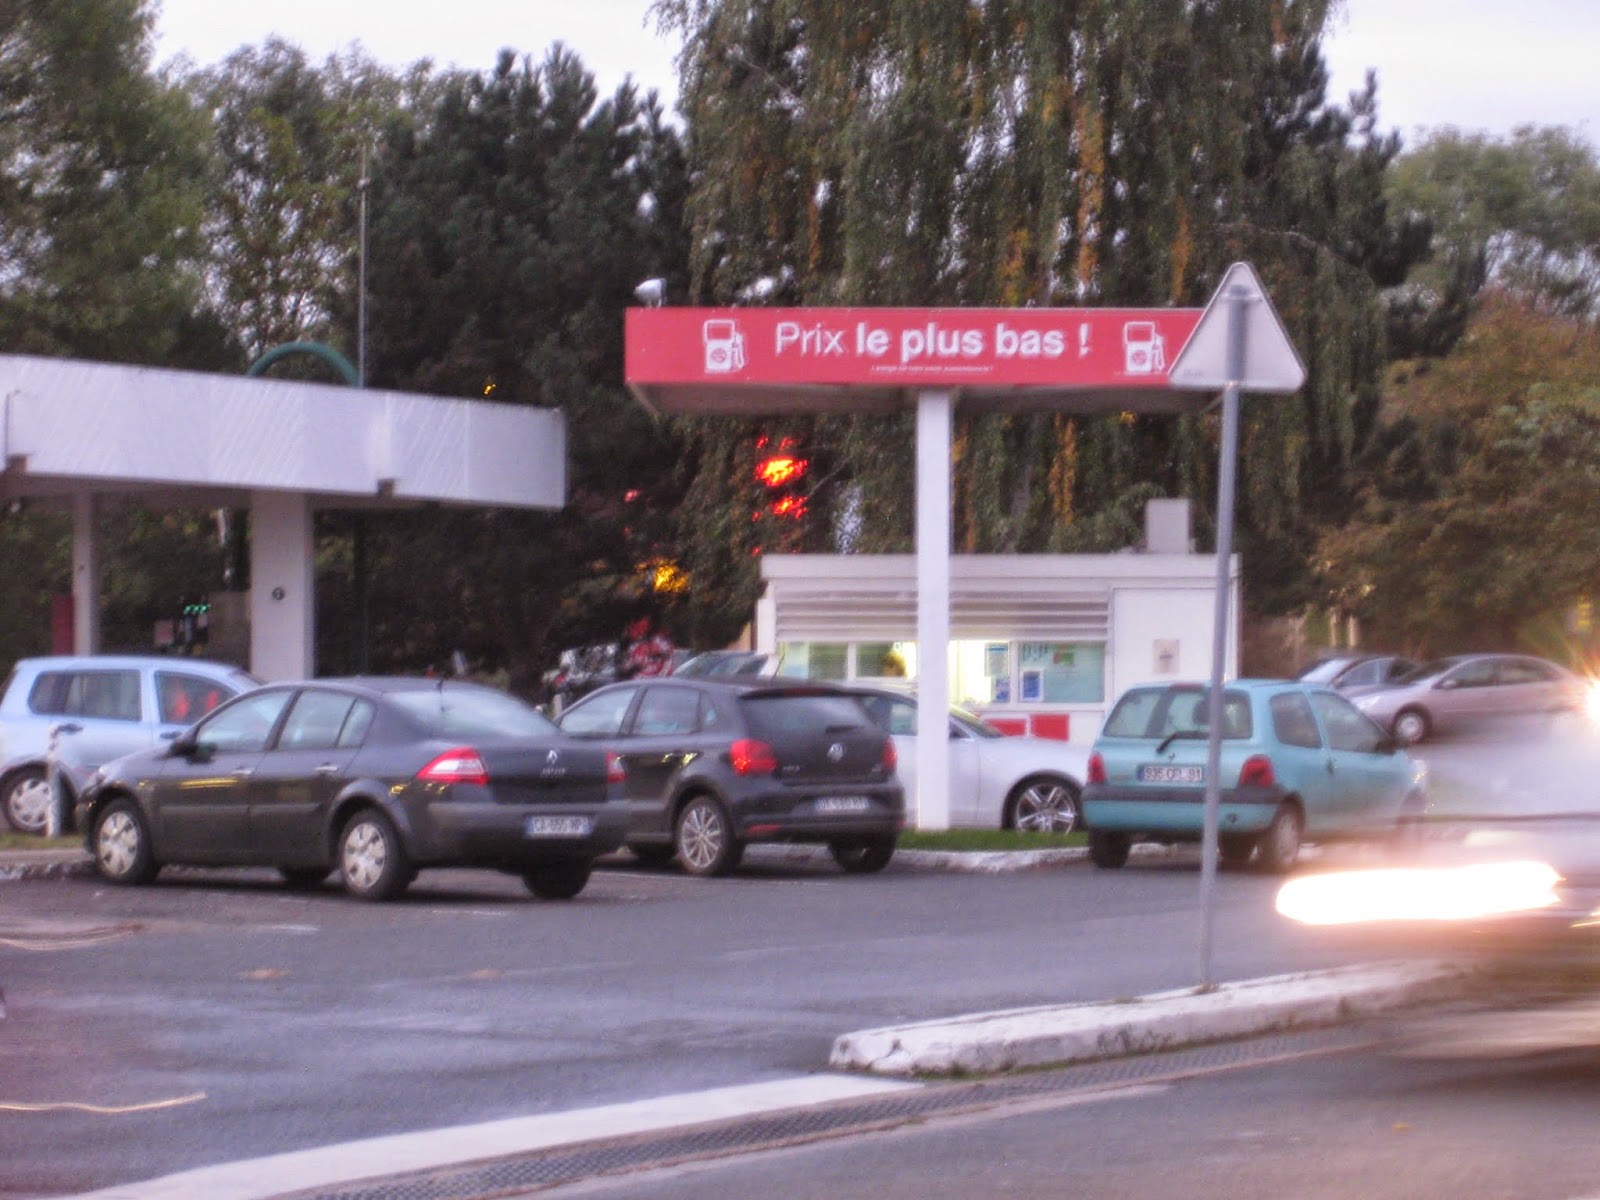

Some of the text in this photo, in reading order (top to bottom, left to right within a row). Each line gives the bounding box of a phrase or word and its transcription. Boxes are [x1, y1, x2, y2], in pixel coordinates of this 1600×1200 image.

[775, 321, 1091, 362] Prix le plus bas !
